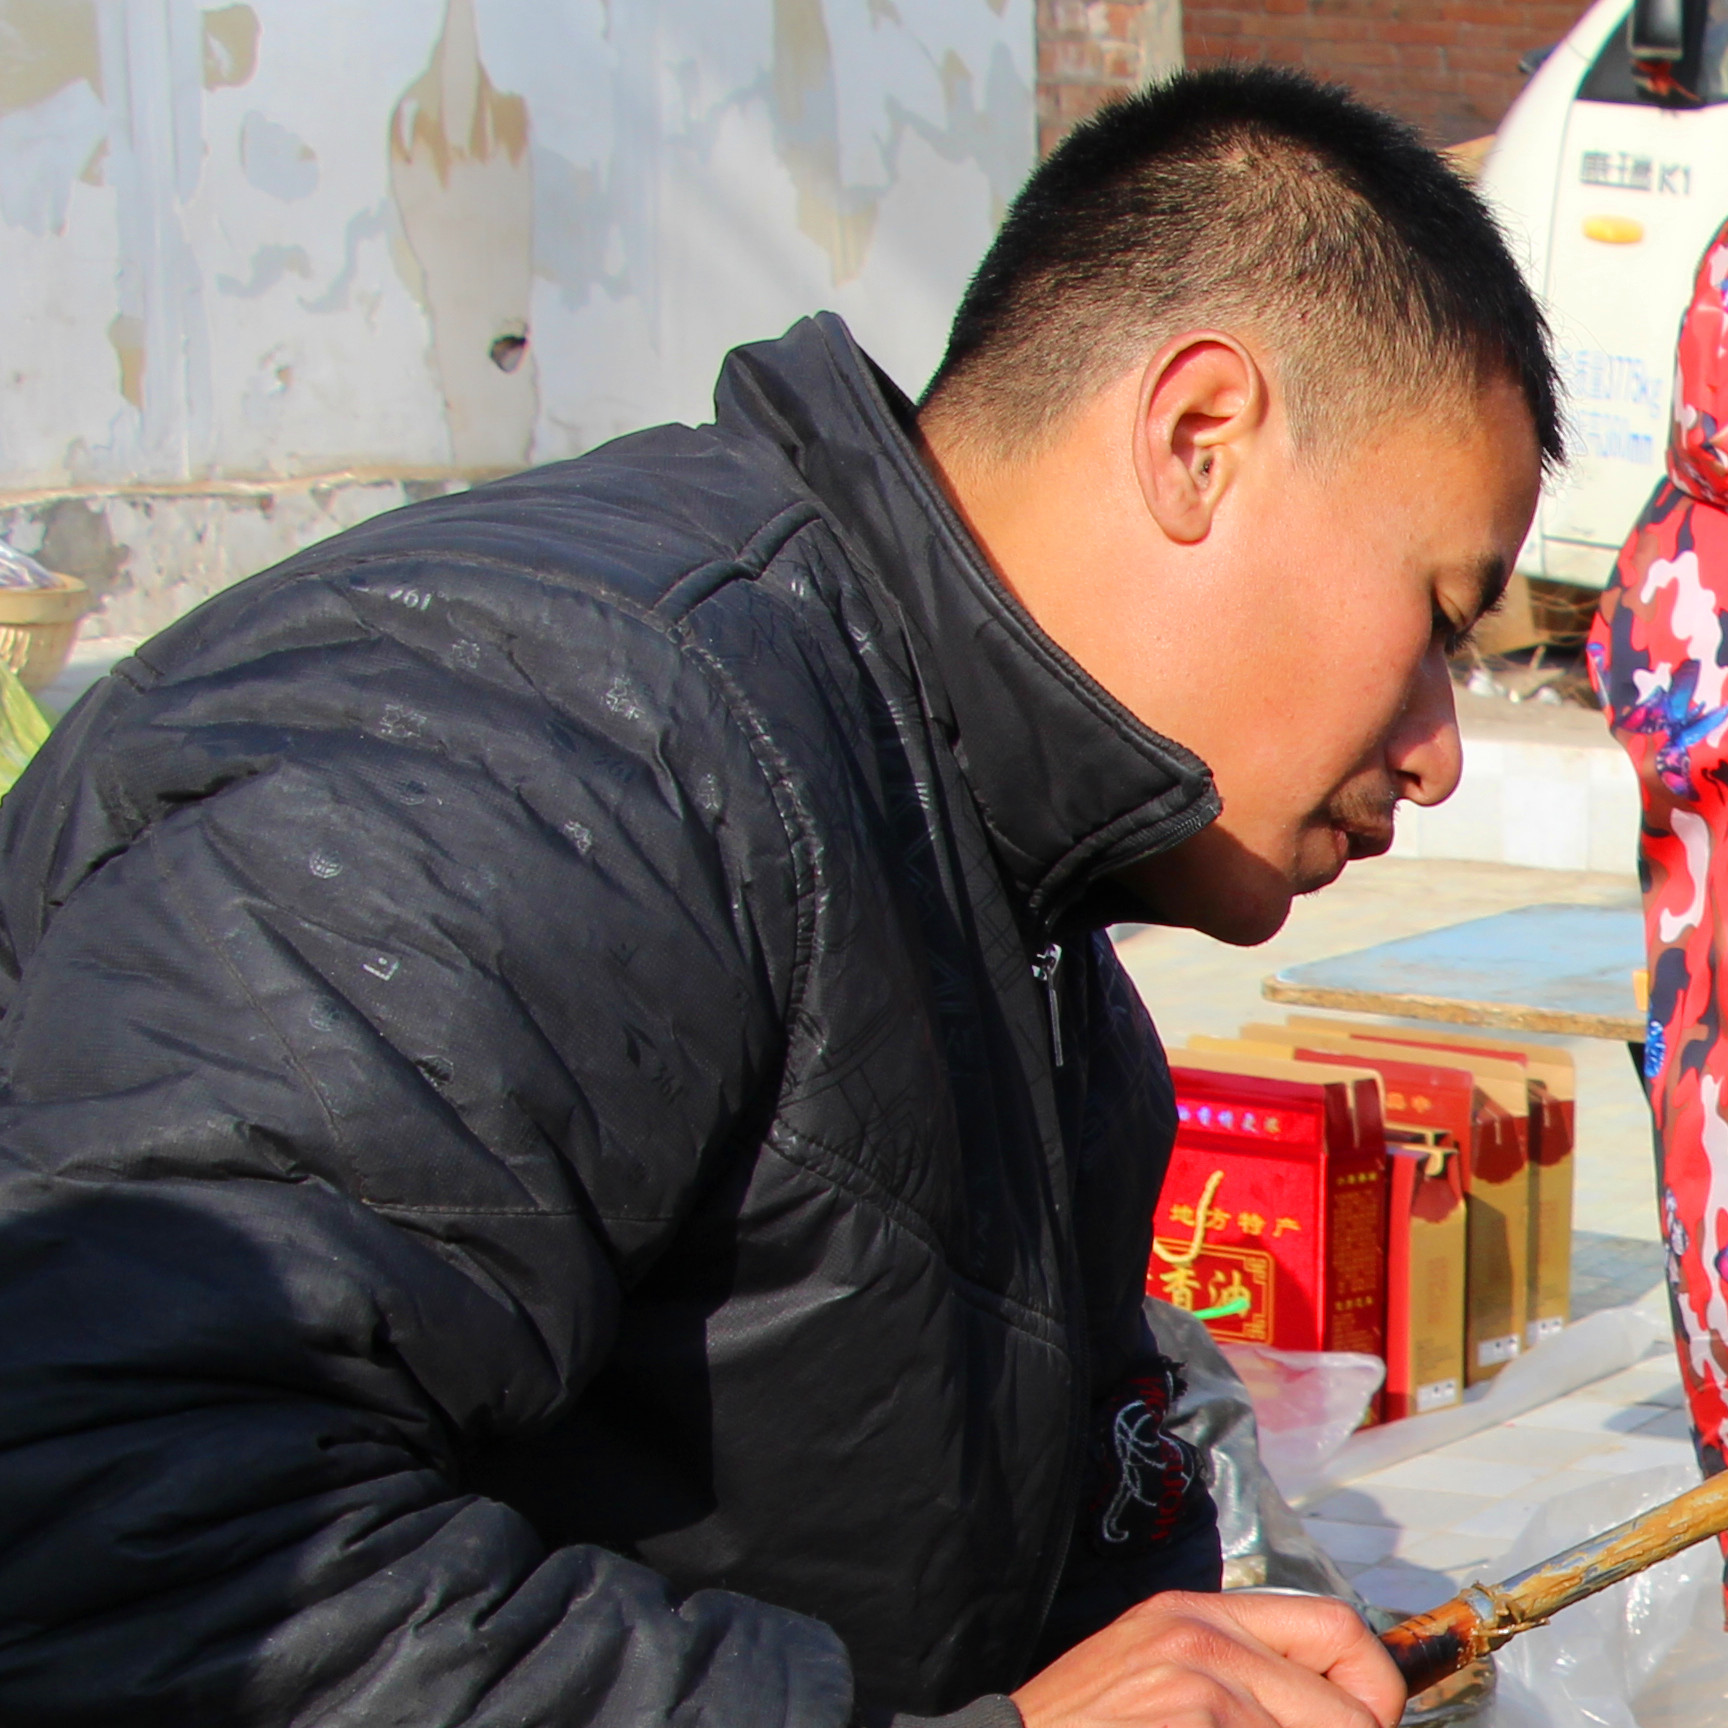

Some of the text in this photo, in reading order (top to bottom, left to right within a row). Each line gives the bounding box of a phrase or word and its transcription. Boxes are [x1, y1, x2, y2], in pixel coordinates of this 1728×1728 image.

[1659, 162, 1692, 195] K1
[1169, 1203, 1302, 1237] 地方特产
